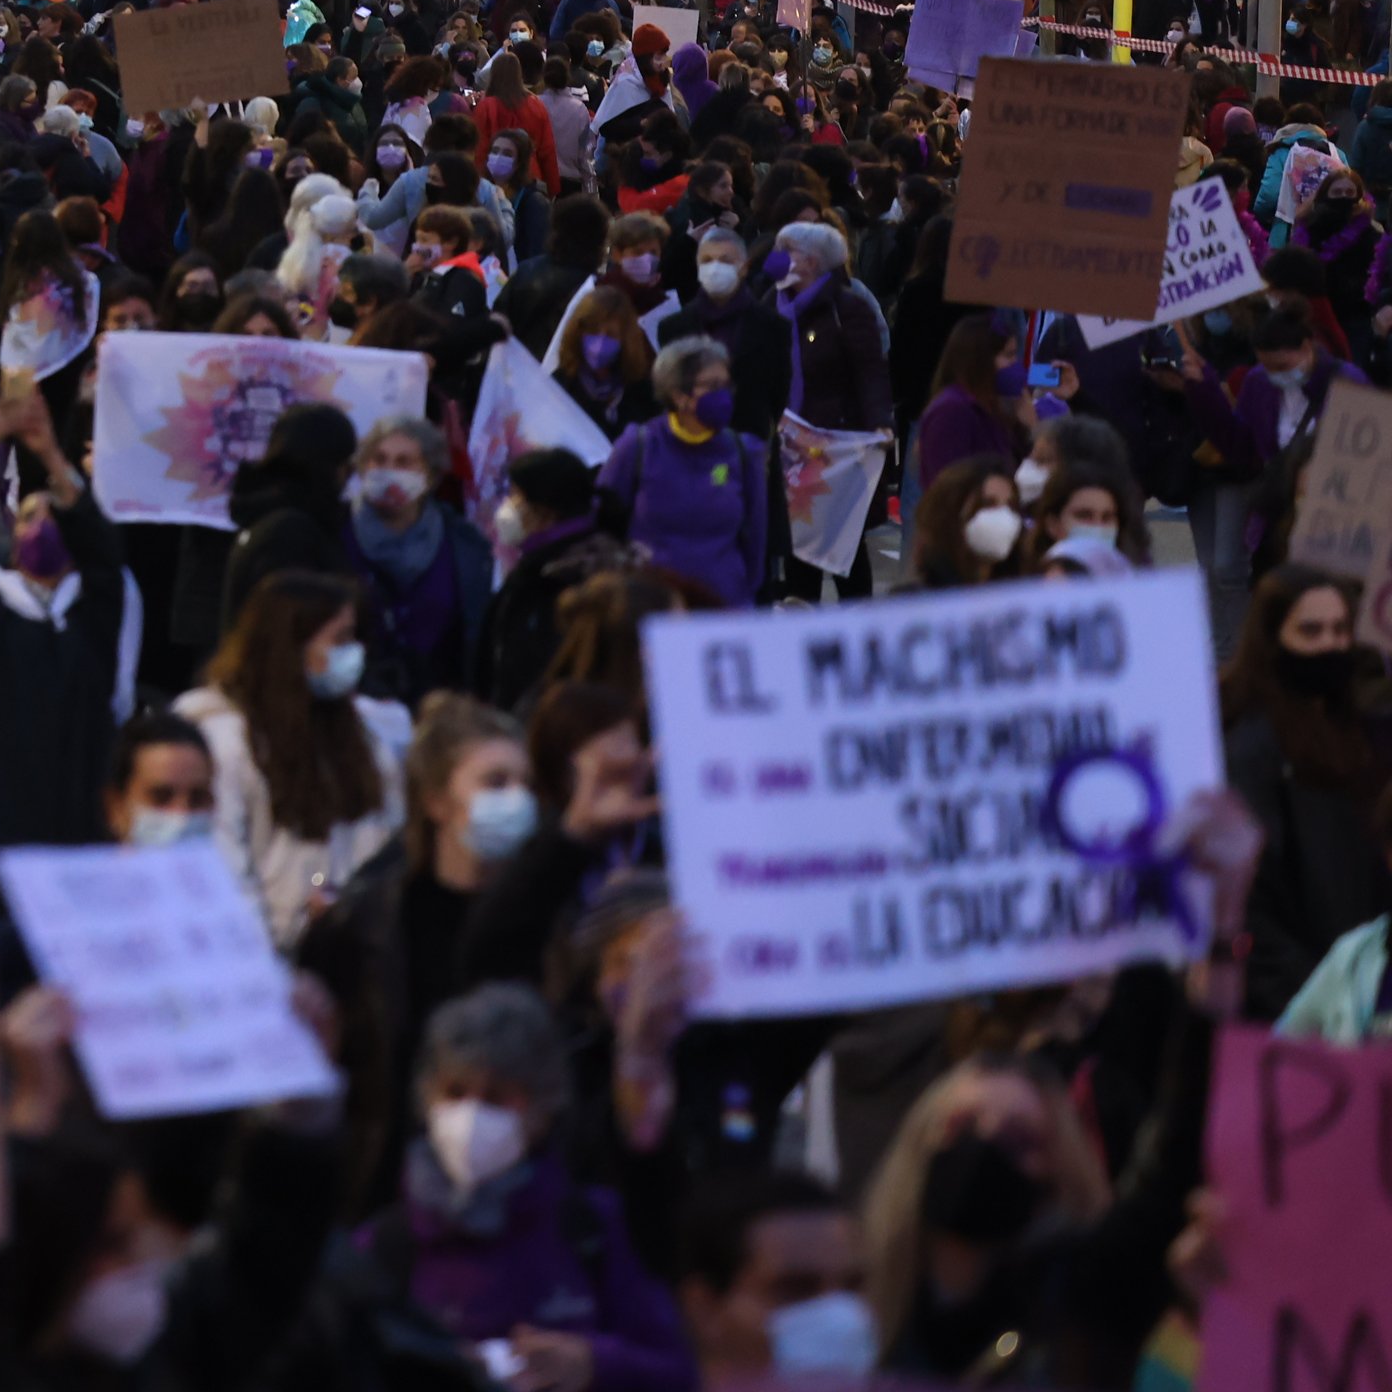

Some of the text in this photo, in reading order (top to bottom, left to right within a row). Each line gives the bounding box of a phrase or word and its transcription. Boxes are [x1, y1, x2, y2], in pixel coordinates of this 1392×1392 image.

[1199, 217, 1218, 238] LA
[1179, 241, 1227, 270] COMO
[701, 598, 1128, 715] EL MACHISMO
[900, 786, 1056, 865] SOCIA
